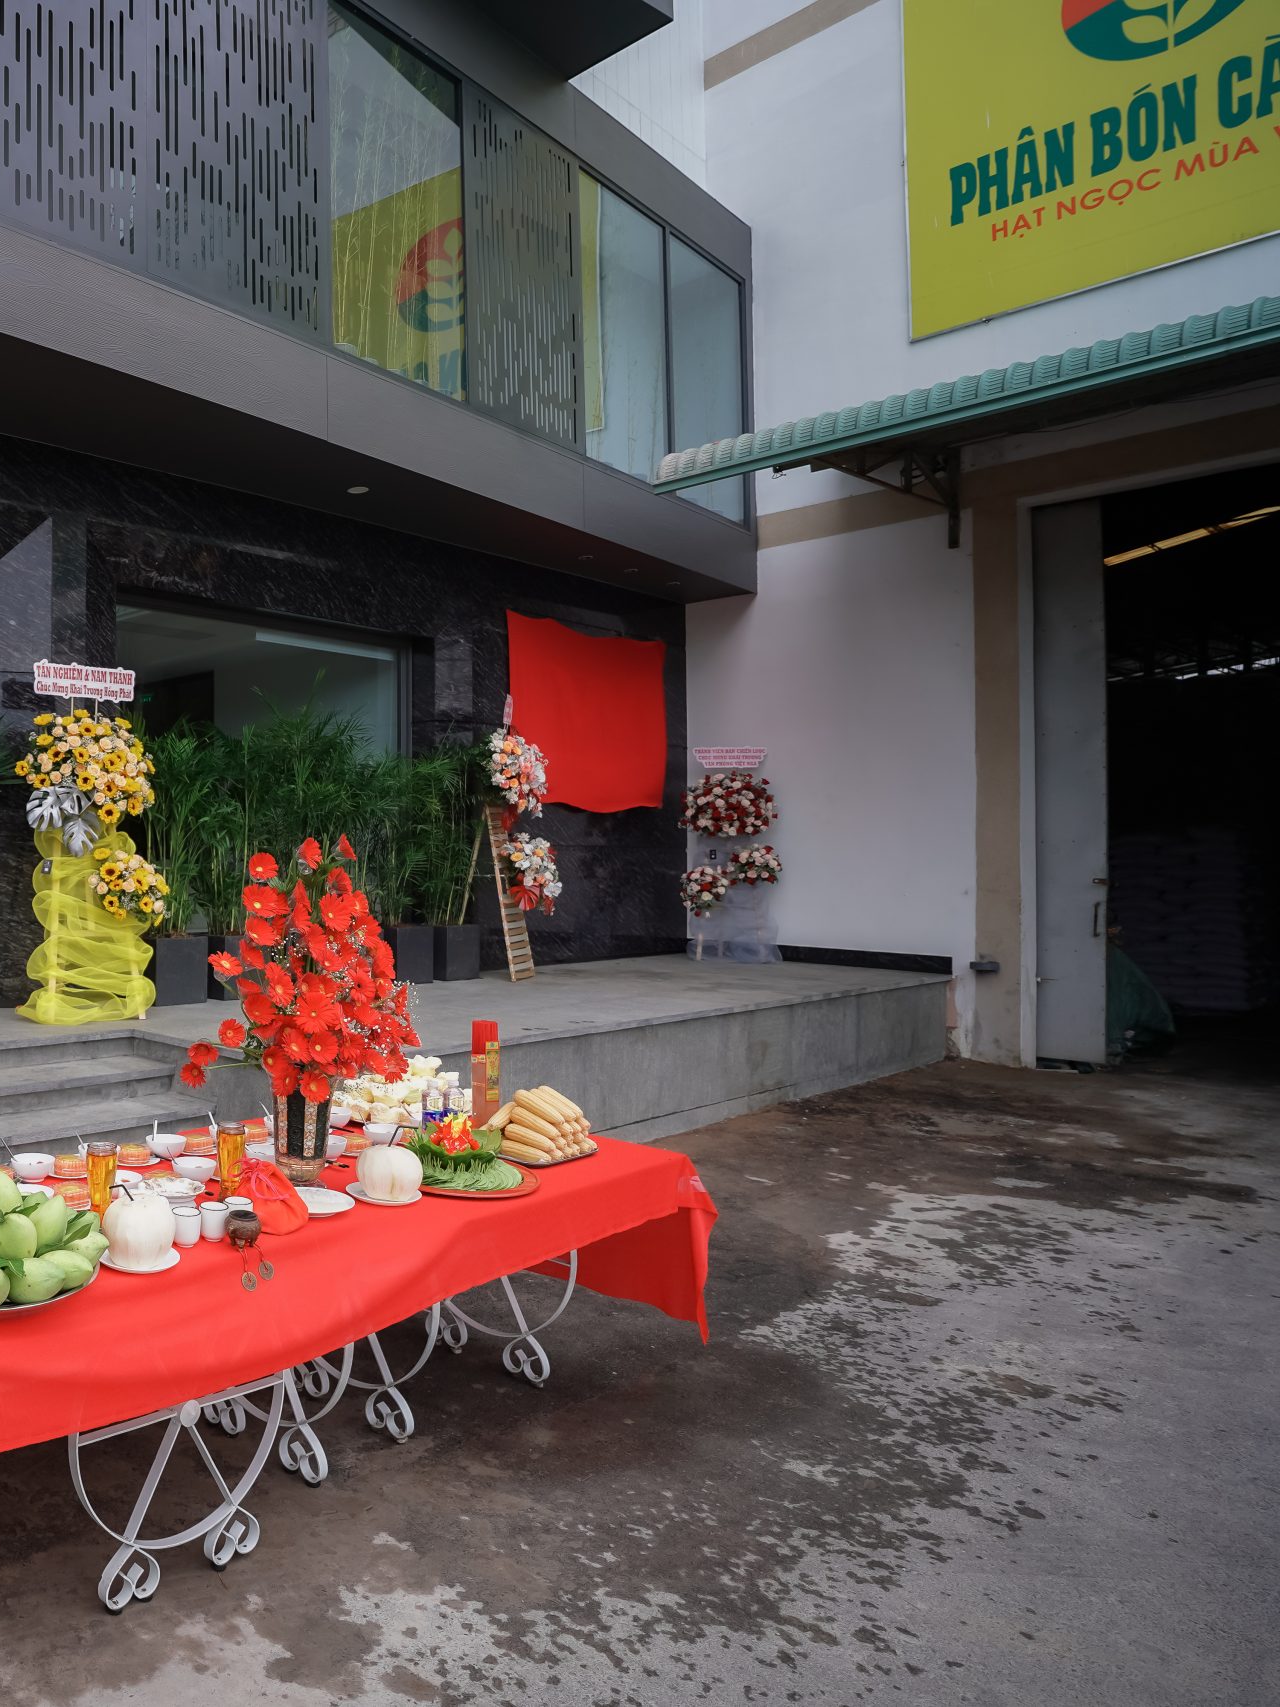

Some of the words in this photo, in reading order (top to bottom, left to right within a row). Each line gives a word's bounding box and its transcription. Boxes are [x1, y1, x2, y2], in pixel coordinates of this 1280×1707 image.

[949, 121, 1075, 227] PHÂN
[1090, 74, 1198, 177] BÓN
[991, 207, 1045, 241] HẠT
[1056, 168, 1162, 220] NGỌC
[1174, 136, 1260, 181] MÙA
[70, 683, 82, 695] Khai
[84, 669, 90, 681] &
[91, 670, 107, 683] NAM
